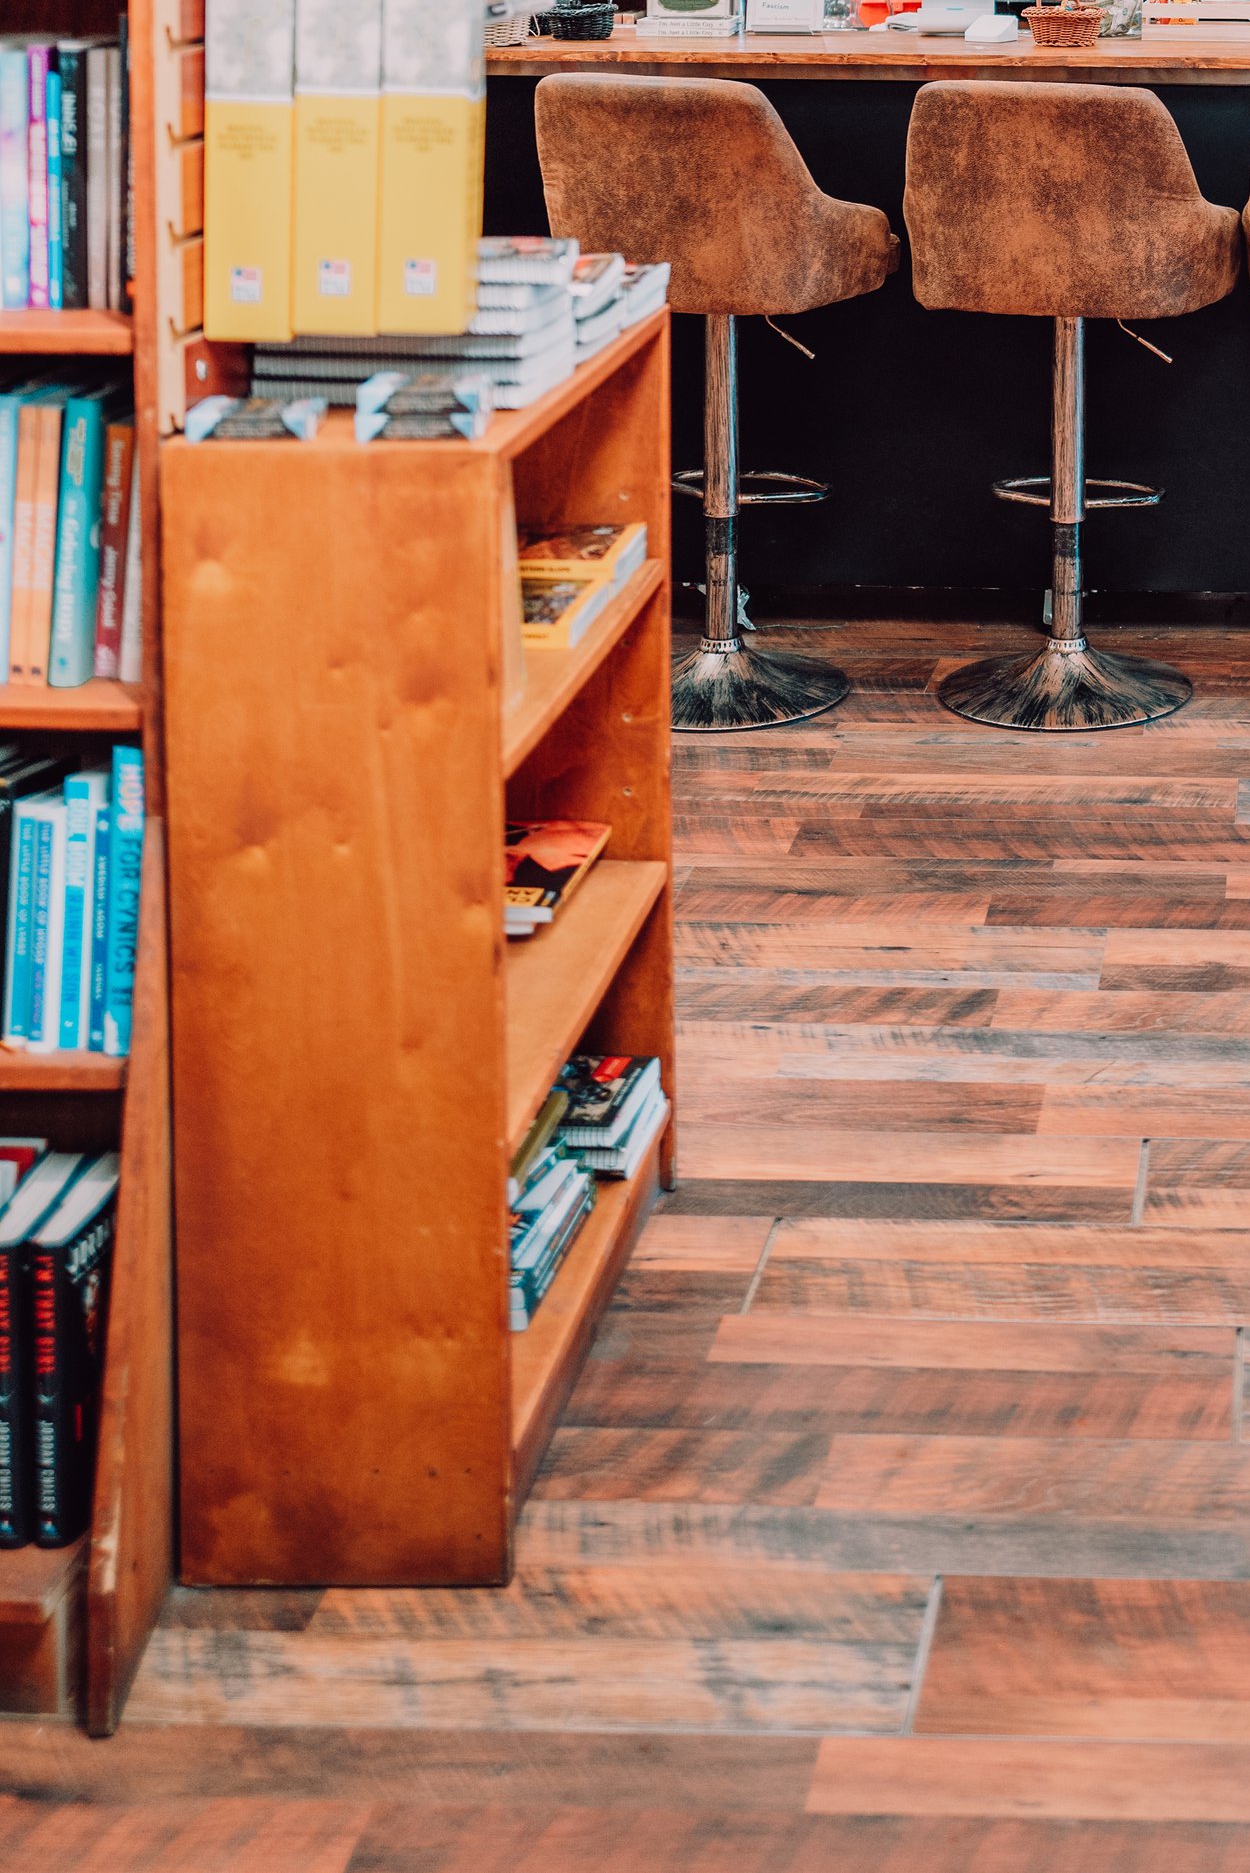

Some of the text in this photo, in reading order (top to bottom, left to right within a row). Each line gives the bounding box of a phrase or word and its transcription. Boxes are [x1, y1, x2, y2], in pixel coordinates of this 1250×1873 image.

[762, 2, 789, 11] Fascism
[109, 439, 125, 487] Saving
[107, 490, 123, 525] Time
[103, 545, 118, 589] Jenny
[116, 763, 144, 974] HOPE FOR CYNICS
[35, 1255, 55, 1282] I'M
[35, 1288, 56, 1328] THAT
[38, 1420, 57, 1512] JORDAN CHILES
